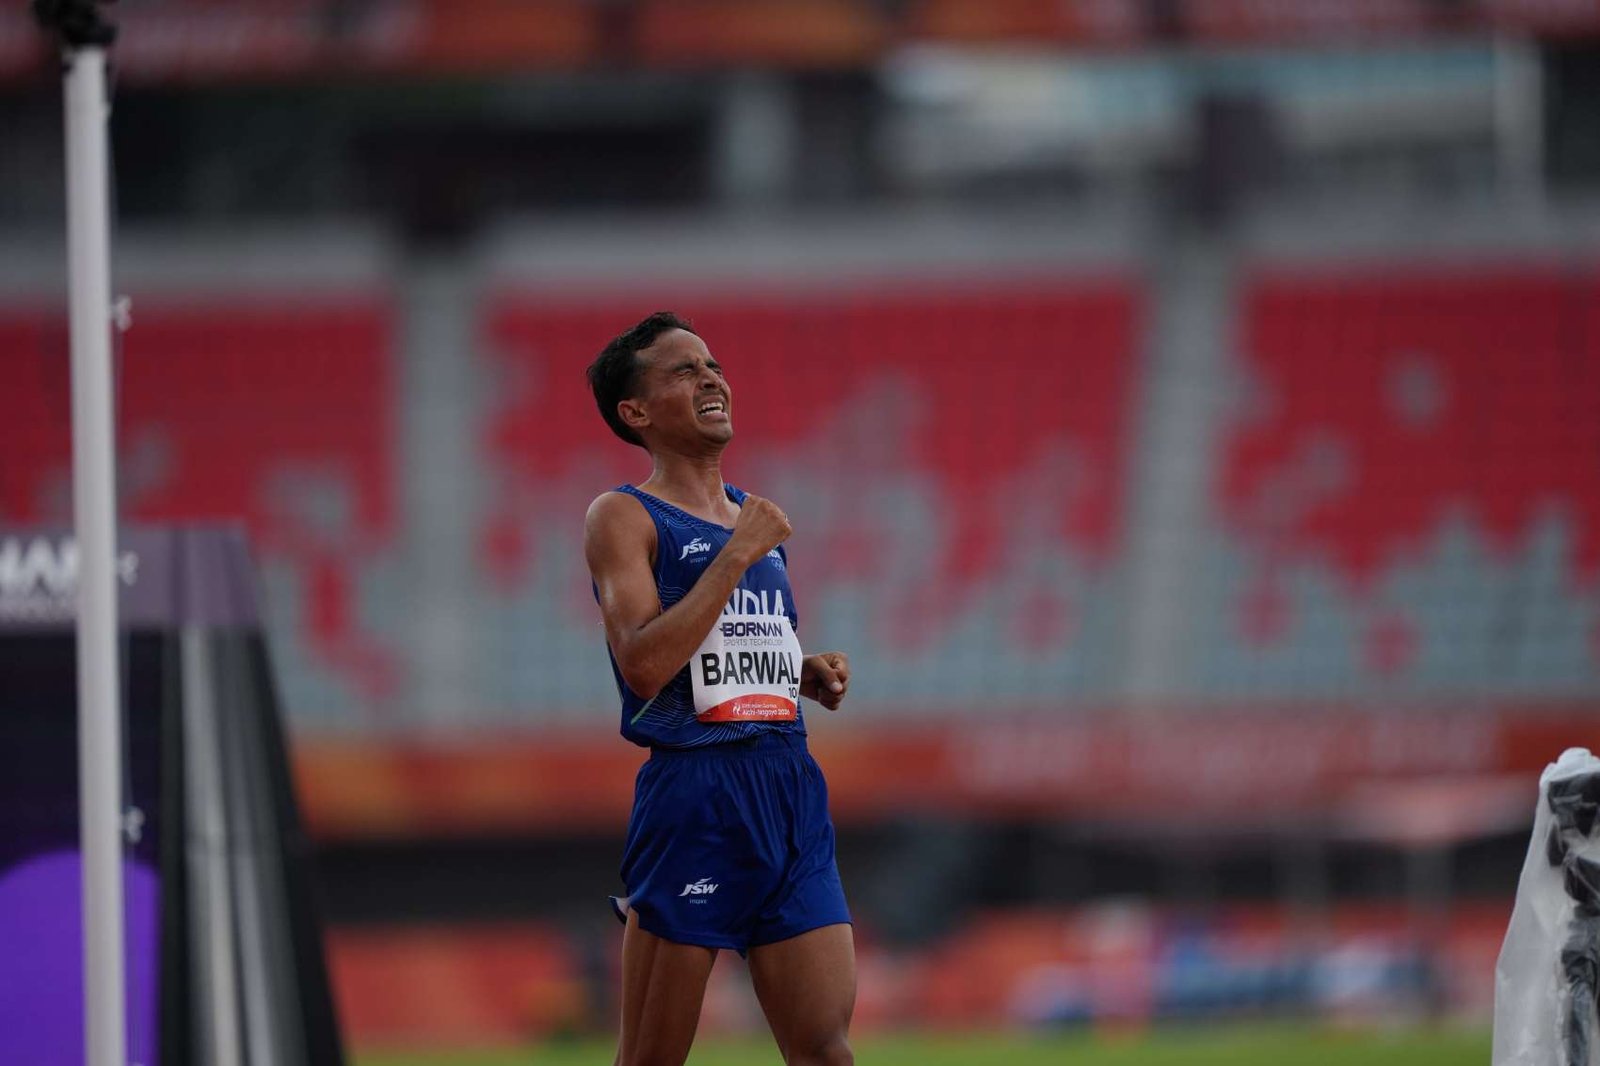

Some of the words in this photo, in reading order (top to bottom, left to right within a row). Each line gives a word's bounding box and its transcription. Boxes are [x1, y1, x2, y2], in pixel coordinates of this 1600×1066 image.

[679, 542, 711, 560] JSW
[722, 588, 785, 616] NDIA
[721, 622, 782, 637] BORNAN
[701, 652, 799, 686] BARWAL
[678, 884, 719, 896] JSW
